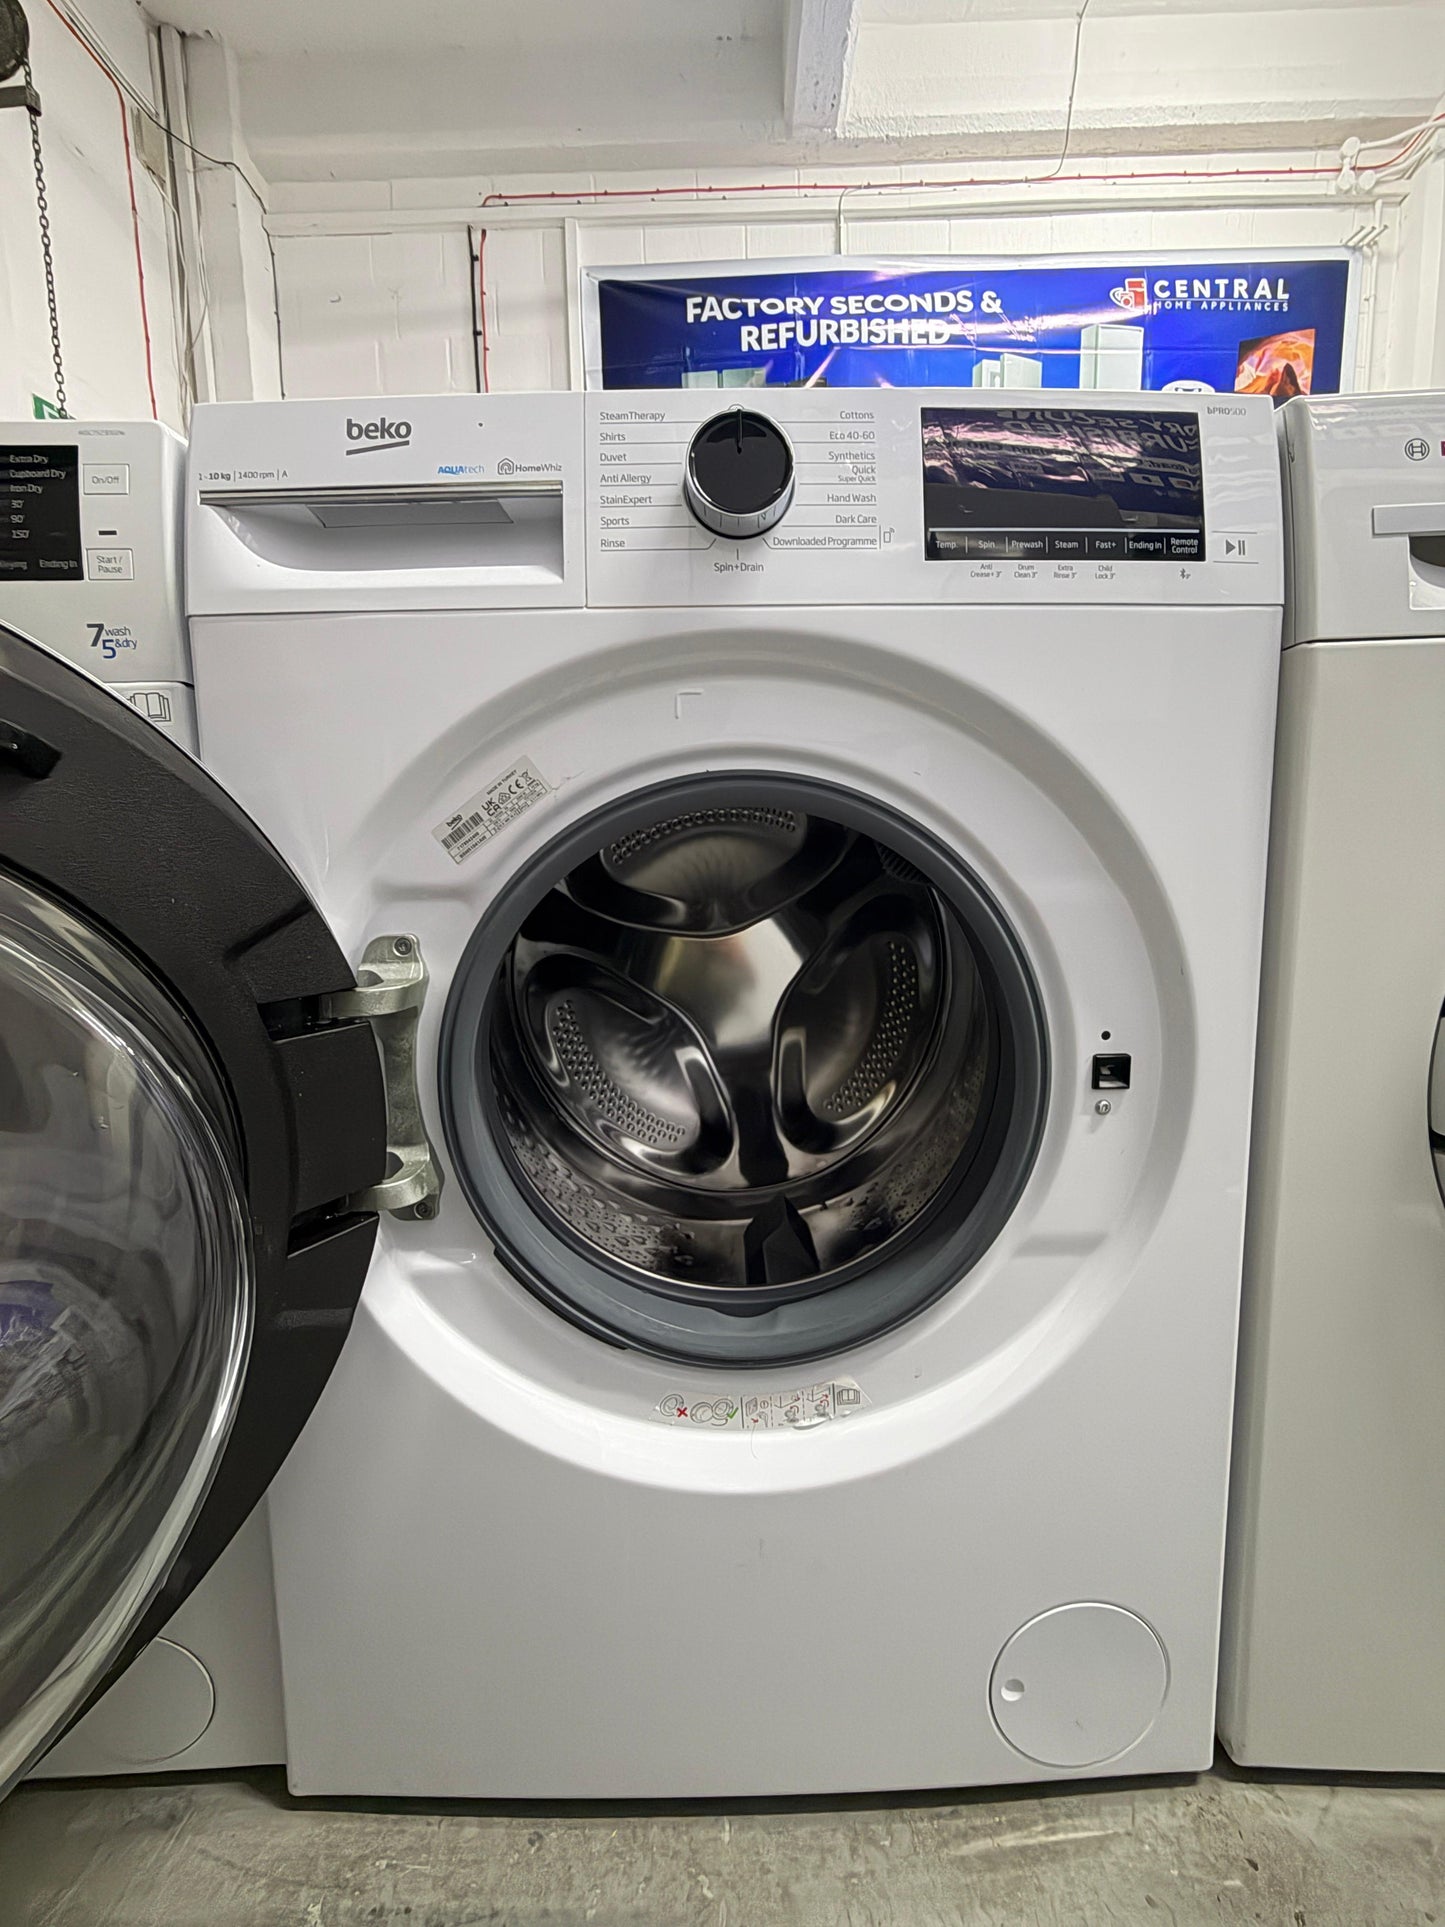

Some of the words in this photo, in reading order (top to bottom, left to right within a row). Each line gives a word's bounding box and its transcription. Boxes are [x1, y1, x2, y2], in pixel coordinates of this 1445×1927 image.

[1154, 278, 1290, 300] CENTRAL
[686, 296, 824, 323] FACTORY
[838, 290, 973, 315] SECONDS
[981, 292, 1003, 314] &
[1155, 301, 1192, 310] HOME
[1201, 301, 1289, 312] APPLIANCES
[740, 318, 950, 352] REFURBISHED
[600, 412, 665, 422] SteamTherapy
[839, 410, 874, 419] Cottons
[346, 417, 412, 440] beko
[600, 432, 626, 441] Shirts
[829, 431, 845, 440] Eco
[846, 431, 875, 440] 40-60
[33, 455, 48, 464] Dry
[600, 453, 627, 462] Duvet
[828, 451, 876, 462] Synthetics
[437, 464, 485, 475] AQUAtech
[515, 463, 562, 473] HomeWhiz
[851, 465, 876, 475] Quick
[10, 469, 50, 479] Cupboard
[51, 469, 66, 480] Dry
[220, 472, 231, 481] kg
[238, 471, 259, 479] 1400
[259, 472, 275, 480] rpm
[282, 470, 288, 478] A
[600, 474, 619, 483] Anti
[619, 474, 652, 485] Allergy
[838, 475, 856, 484] Super
[857, 475, 876, 483] Quick
[27, 484, 43, 494] Dry
[600, 495, 652, 505] StainExpert
[827, 493, 849, 503] Hand
[850, 493, 876, 503] Wash
[600, 516, 630, 527] Sports
[835, 514, 856, 524] Dark
[857, 514, 877, 524] Care
[600, 538, 625, 548] Rinse
[773, 536, 827, 547] Downloaded
[827, 537, 877, 548] Programme
[1011, 540, 1044, 549] Prewash
[1055, 540, 1079, 549] Steam
[1095, 541, 1117, 549] Fast+
[1129, 541, 1154, 551] Ending
[1154, 541, 1162, 550] In
[1170, 537, 1199, 546] Remote
[1171, 545, 1198, 554] Control
[97, 564, 123, 573] Pause
[714, 562, 764, 573] Spin+Drain
[86, 623, 105, 647] 7
[105, 626, 131, 637] wash
[102, 639, 117, 659] 5
[115, 637, 138, 650] &dry
[446, 814, 463, 828] beko
